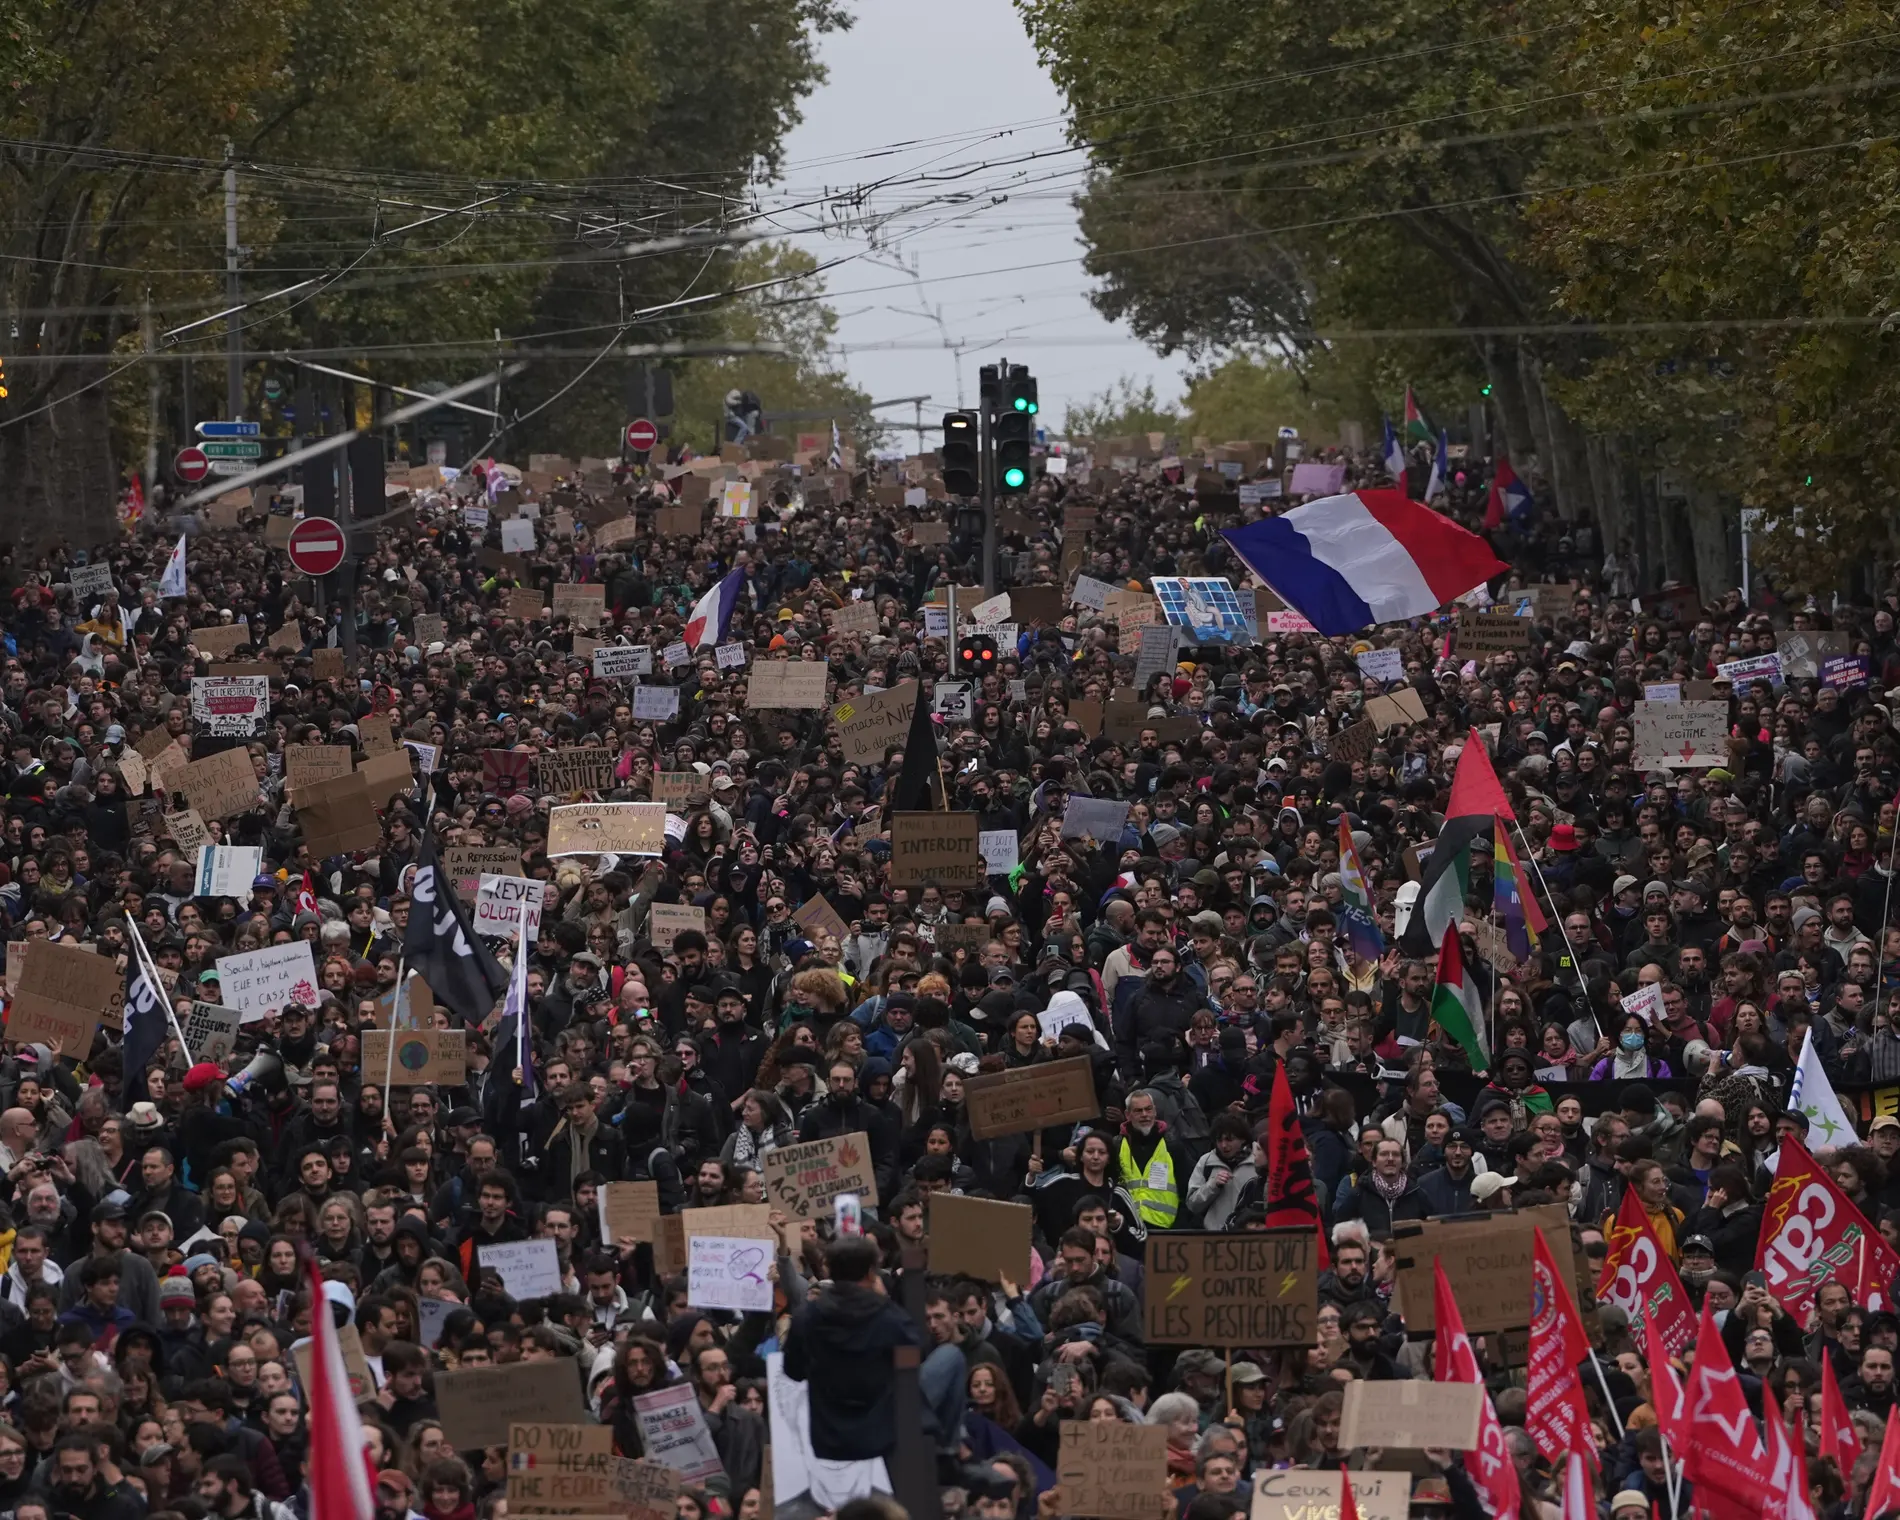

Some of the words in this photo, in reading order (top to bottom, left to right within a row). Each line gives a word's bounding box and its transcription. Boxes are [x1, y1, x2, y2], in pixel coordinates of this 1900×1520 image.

[865, 696, 888, 714] la
[1664, 728, 1707, 739] LÉGITIME
[290, 747, 332, 761] ARTICLE
[854, 738, 870, 755] la
[568, 752, 583, 761] EU
[584, 750, 609, 761] PEUR
[293, 767, 325, 777] DROIT
[541, 760, 569, 770] QU'ON
[540, 766, 612, 795] BASTILLE?
[602, 806, 623, 817] SOUS
[901, 838, 974, 855] INTERDIT
[451, 852, 463, 864] LA
[452, 866, 477, 876] MENE
[256, 974, 271, 987] EST
[278, 970, 290, 981] LA
[193, 1003, 211, 1018] LES
[237, 997, 251, 1011] LA
[185, 1028, 210, 1042] C'EST
[767, 1140, 835, 1167] ETUDIANTS
[797, 1165, 839, 1188] CONTRE
[770, 1176, 811, 1217] ACAB
[1152, 1241, 1191, 1275] LES
[1202, 1239, 1267, 1273] PESTES
[1465, 1251, 1533, 1275] POUDLA
[1201, 1276, 1267, 1299] CONTRE
[1151, 1304, 1192, 1339] LES
[1203, 1300, 1309, 1342] PESTICIDES
[514, 1426, 542, 1450] DO
[546, 1427, 583, 1451] YOU
[1096, 1423, 1147, 1446] D'EAU
[556, 1452, 609, 1476] HEAR
[508, 1475, 544, 1500] THE
[551, 1474, 607, 1500] PEOPLE
[1261, 1472, 1332, 1498] Ceux
